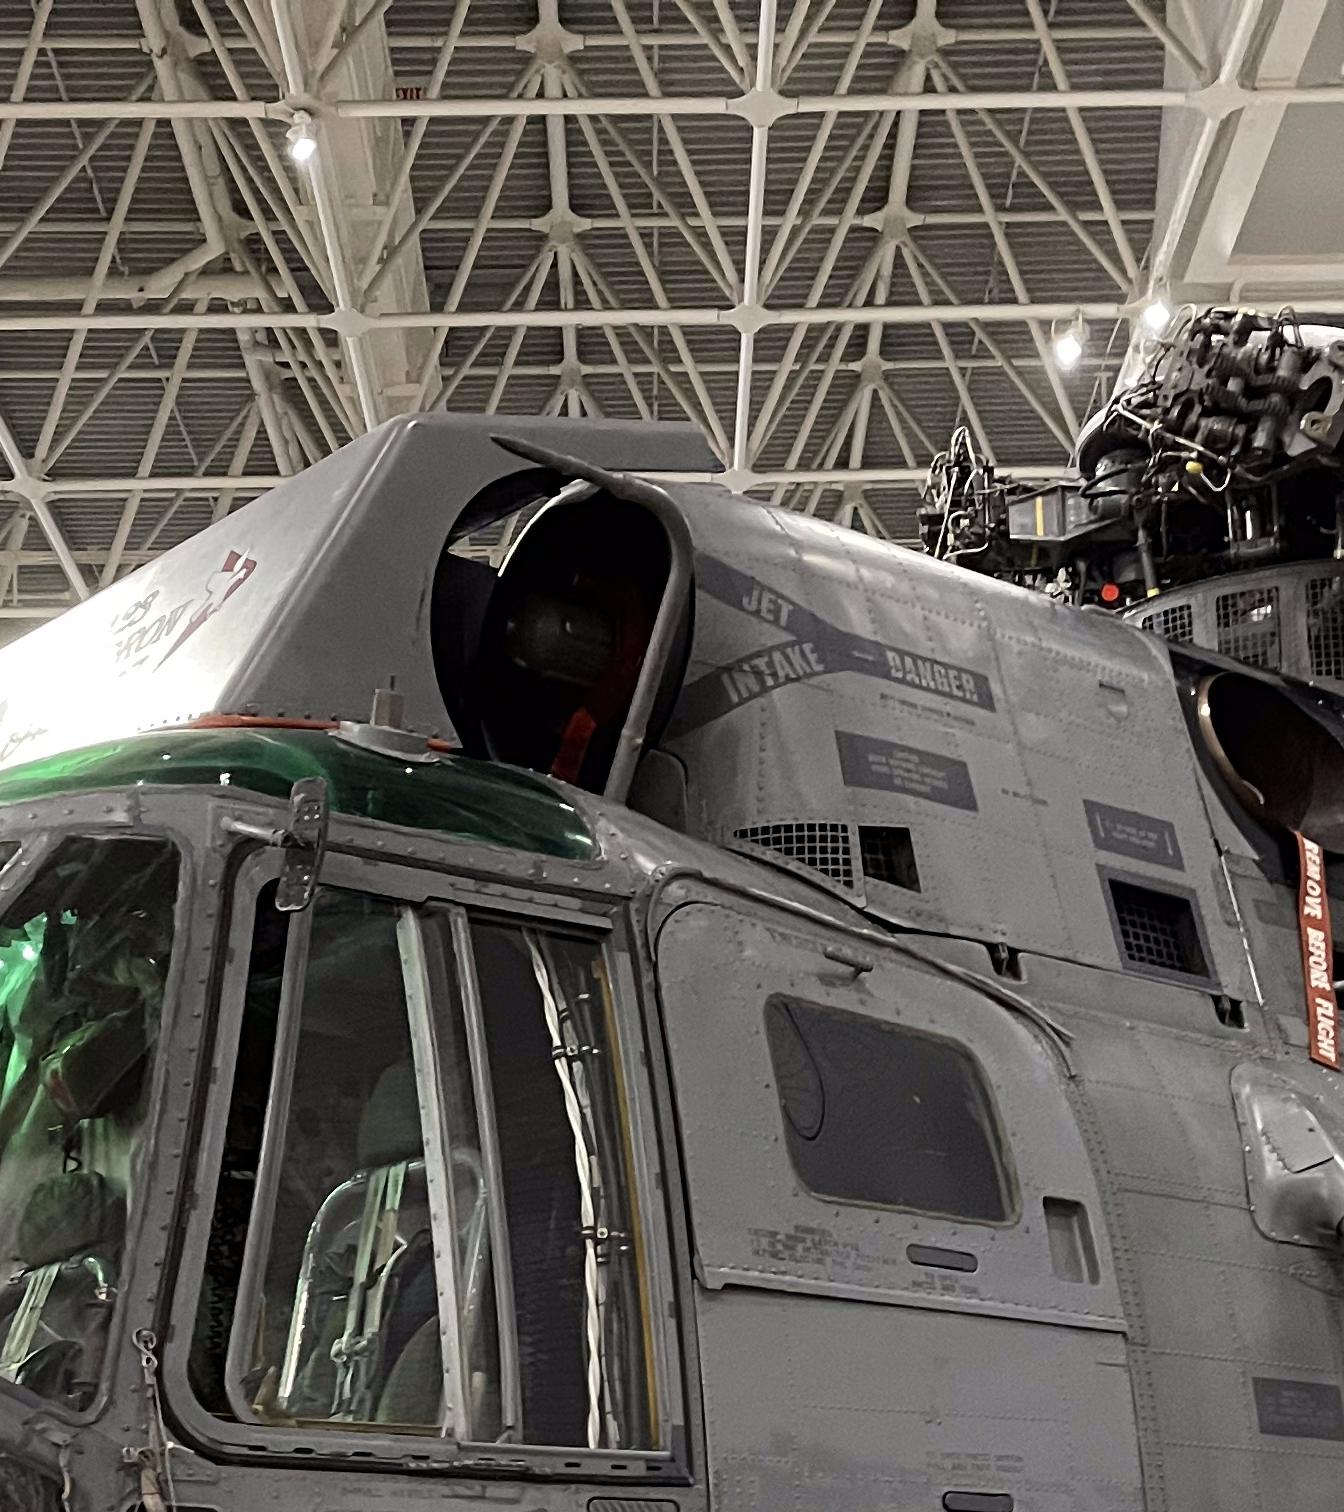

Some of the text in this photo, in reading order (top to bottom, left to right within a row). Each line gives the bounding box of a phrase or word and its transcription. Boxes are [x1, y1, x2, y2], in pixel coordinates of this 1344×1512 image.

[742, 585, 794, 627] JET
[720, 642, 825, 703] INTAKE
[885, 650, 979, 701] DANGER
[1303, 838, 1337, 1063] REMOVE BEFORE FLIGHT
